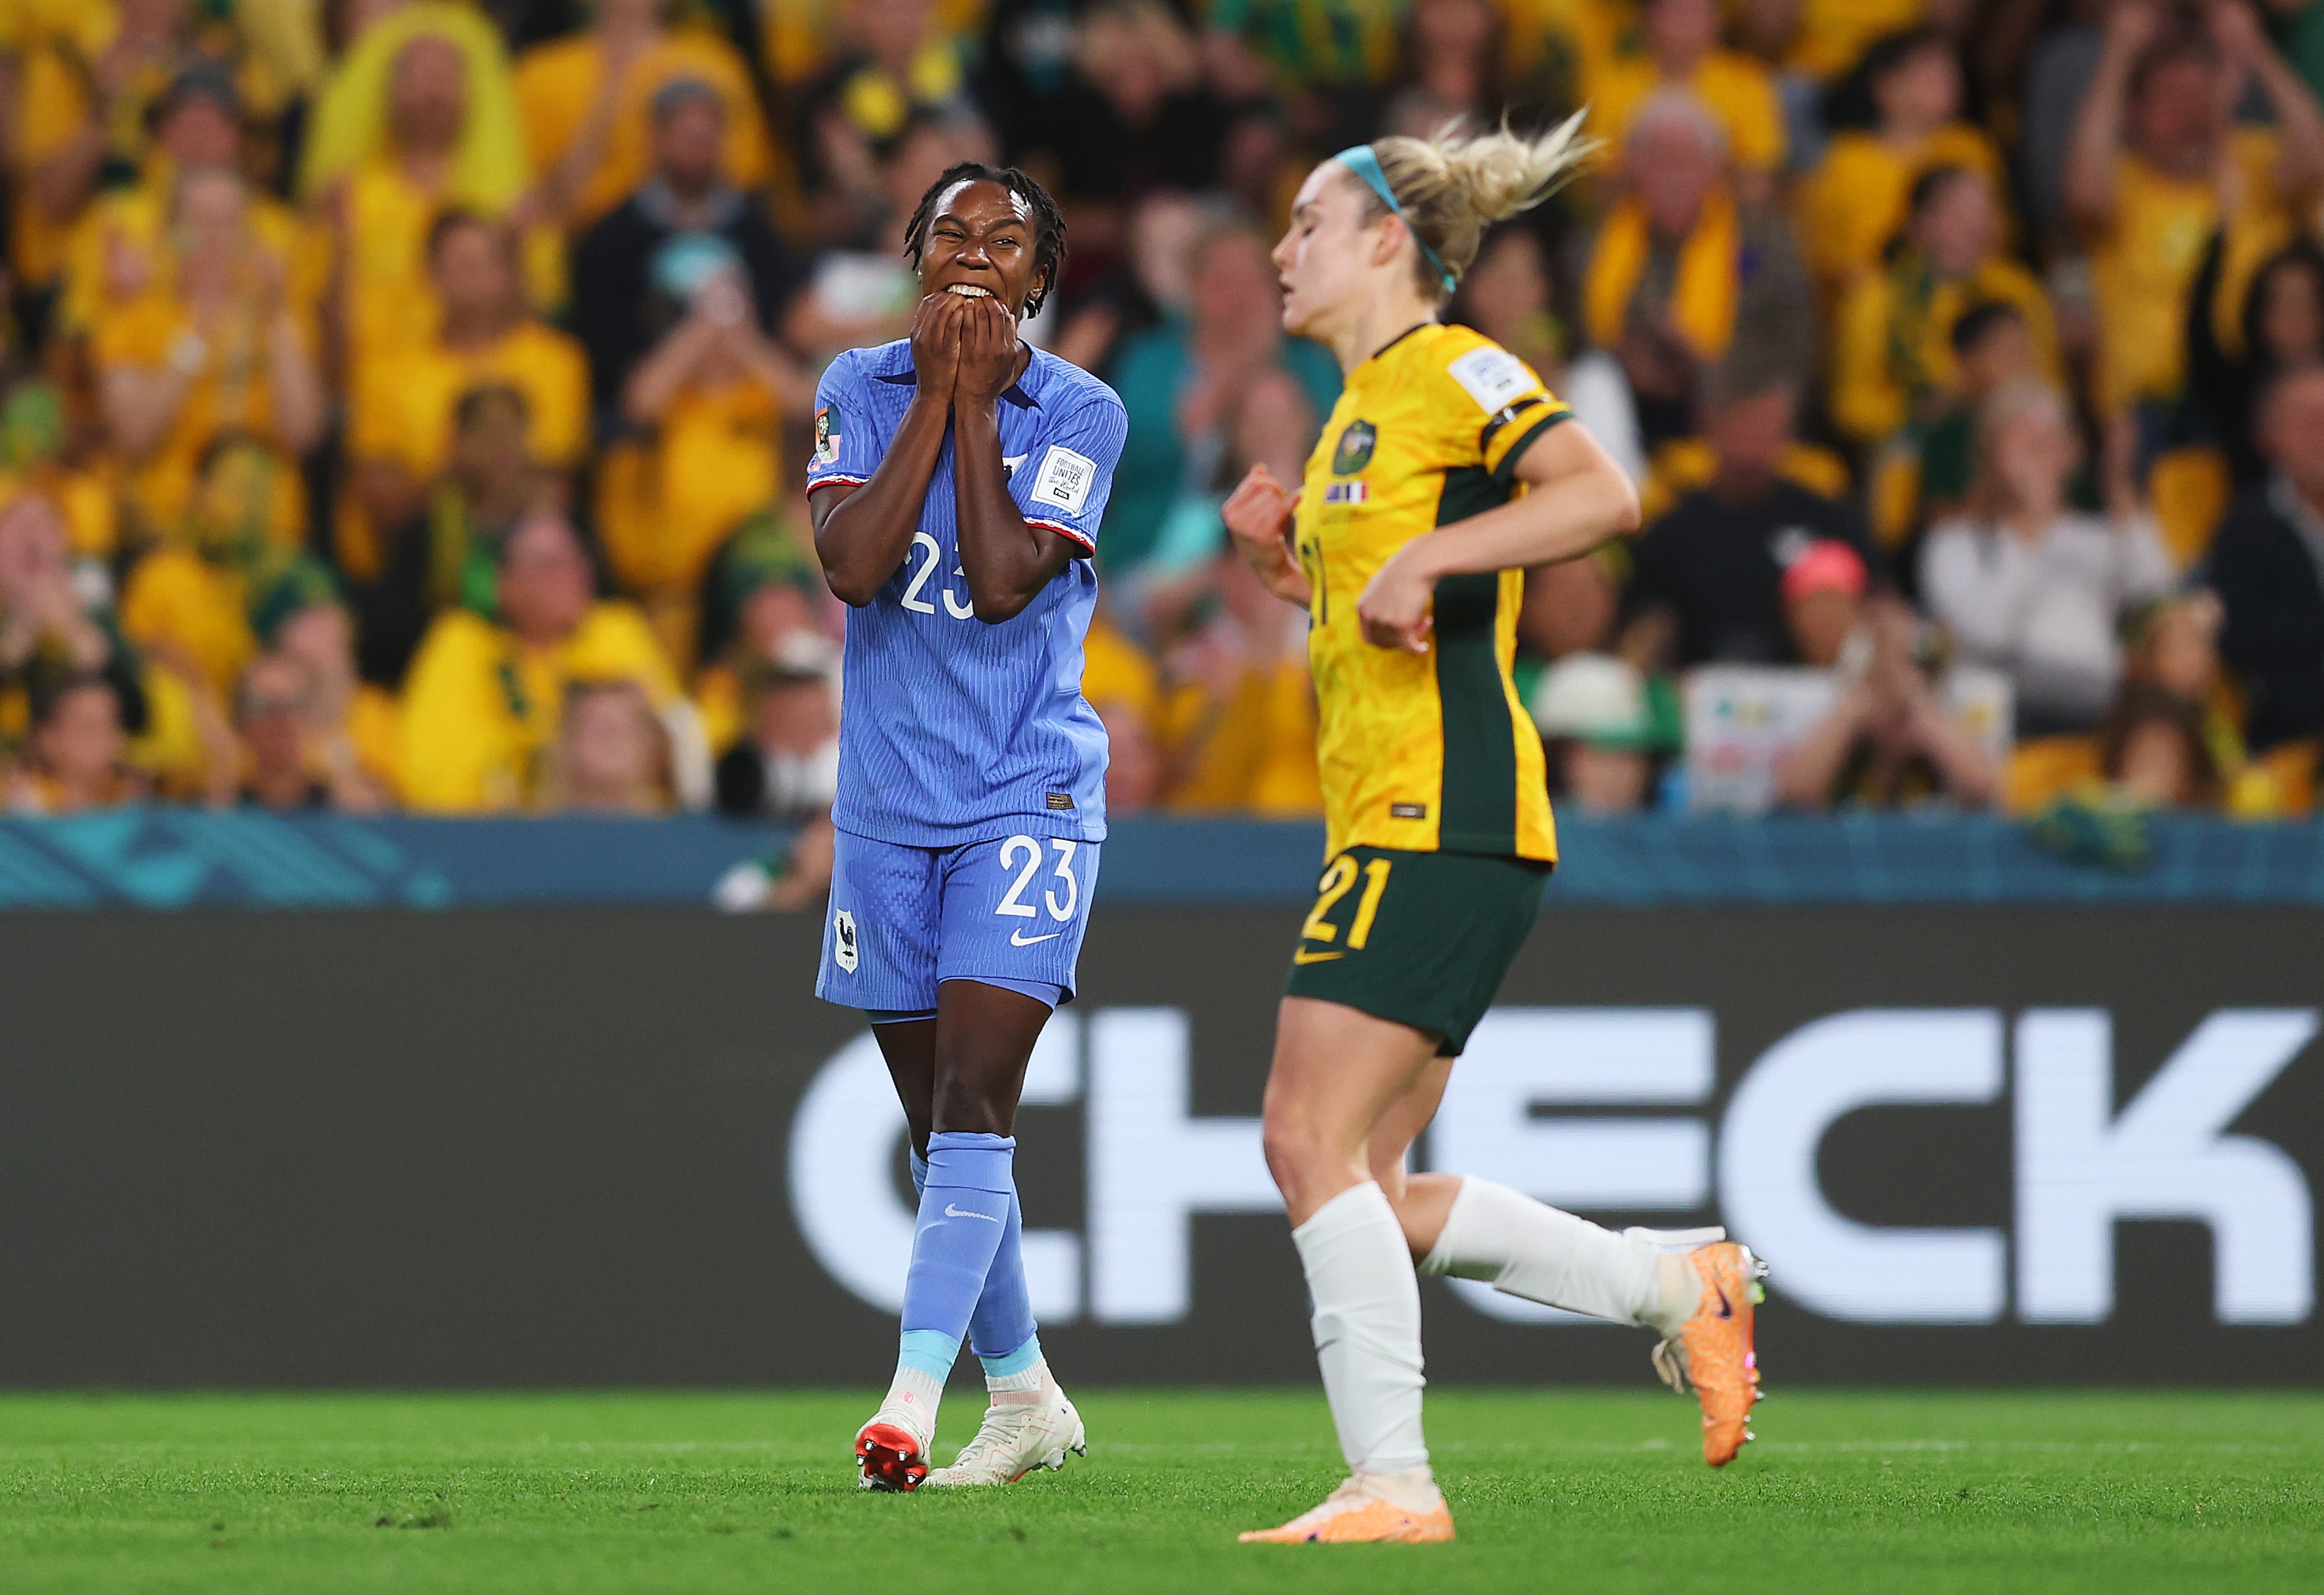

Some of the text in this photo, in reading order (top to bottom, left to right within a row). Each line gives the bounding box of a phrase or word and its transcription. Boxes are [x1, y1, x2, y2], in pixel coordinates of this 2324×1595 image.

[1048, 475, 1080, 495] the World
[1053, 465, 1081, 486] UNITES
[1056, 457, 1085, 477] FOOTBALL
[995, 835, 1077, 922] 23
[1300, 854, 1393, 950] 21
[788, 1006, 2319, 1326] CHECK
